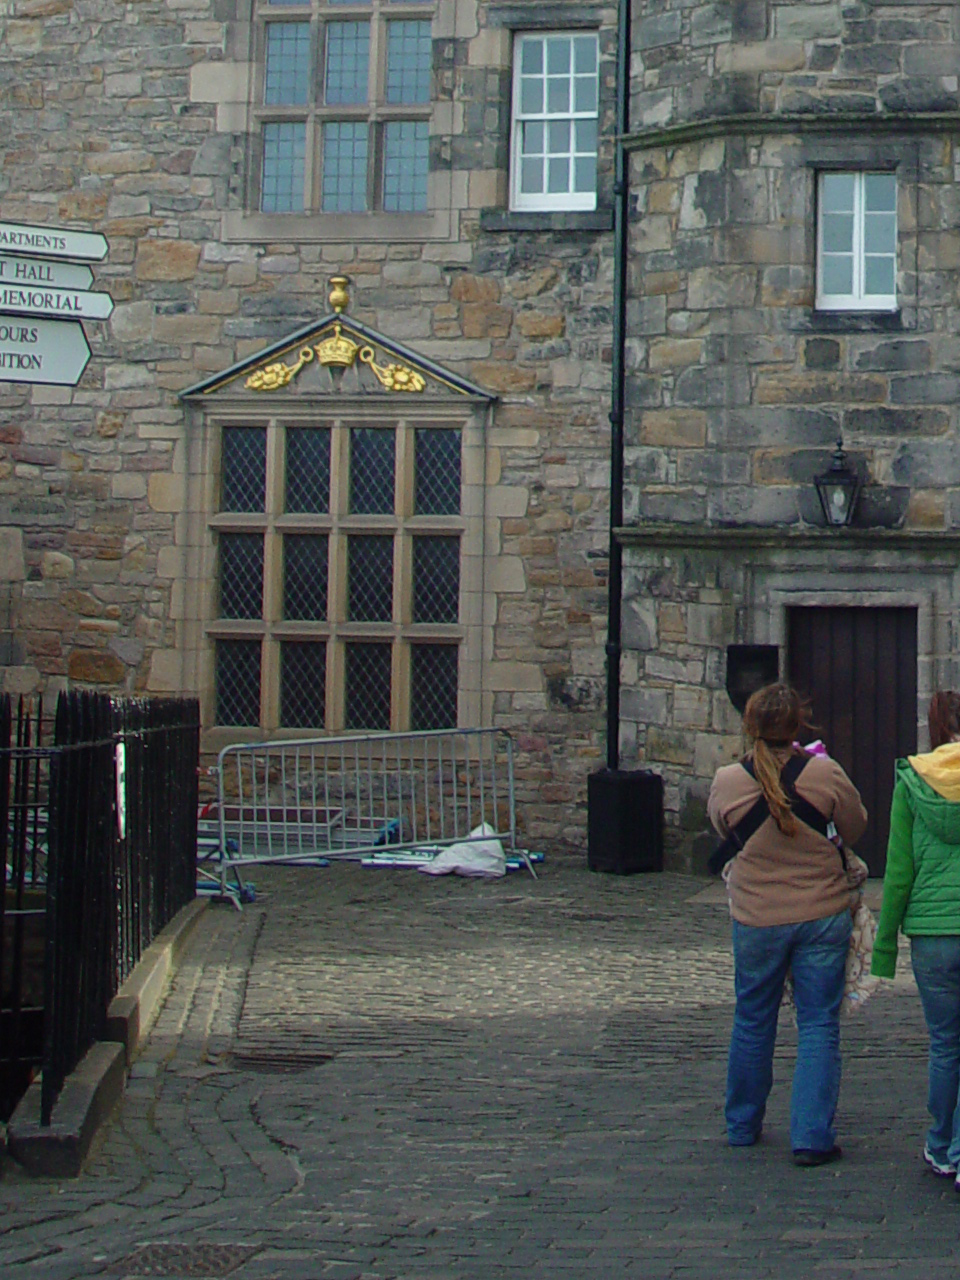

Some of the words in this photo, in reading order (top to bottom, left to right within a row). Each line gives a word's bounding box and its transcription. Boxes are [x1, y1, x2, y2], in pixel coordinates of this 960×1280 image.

[0, 231, 66, 250] ARTMENTS
[15, 262, 54, 282] HALL
[0, 351, 42, 370] ITION
